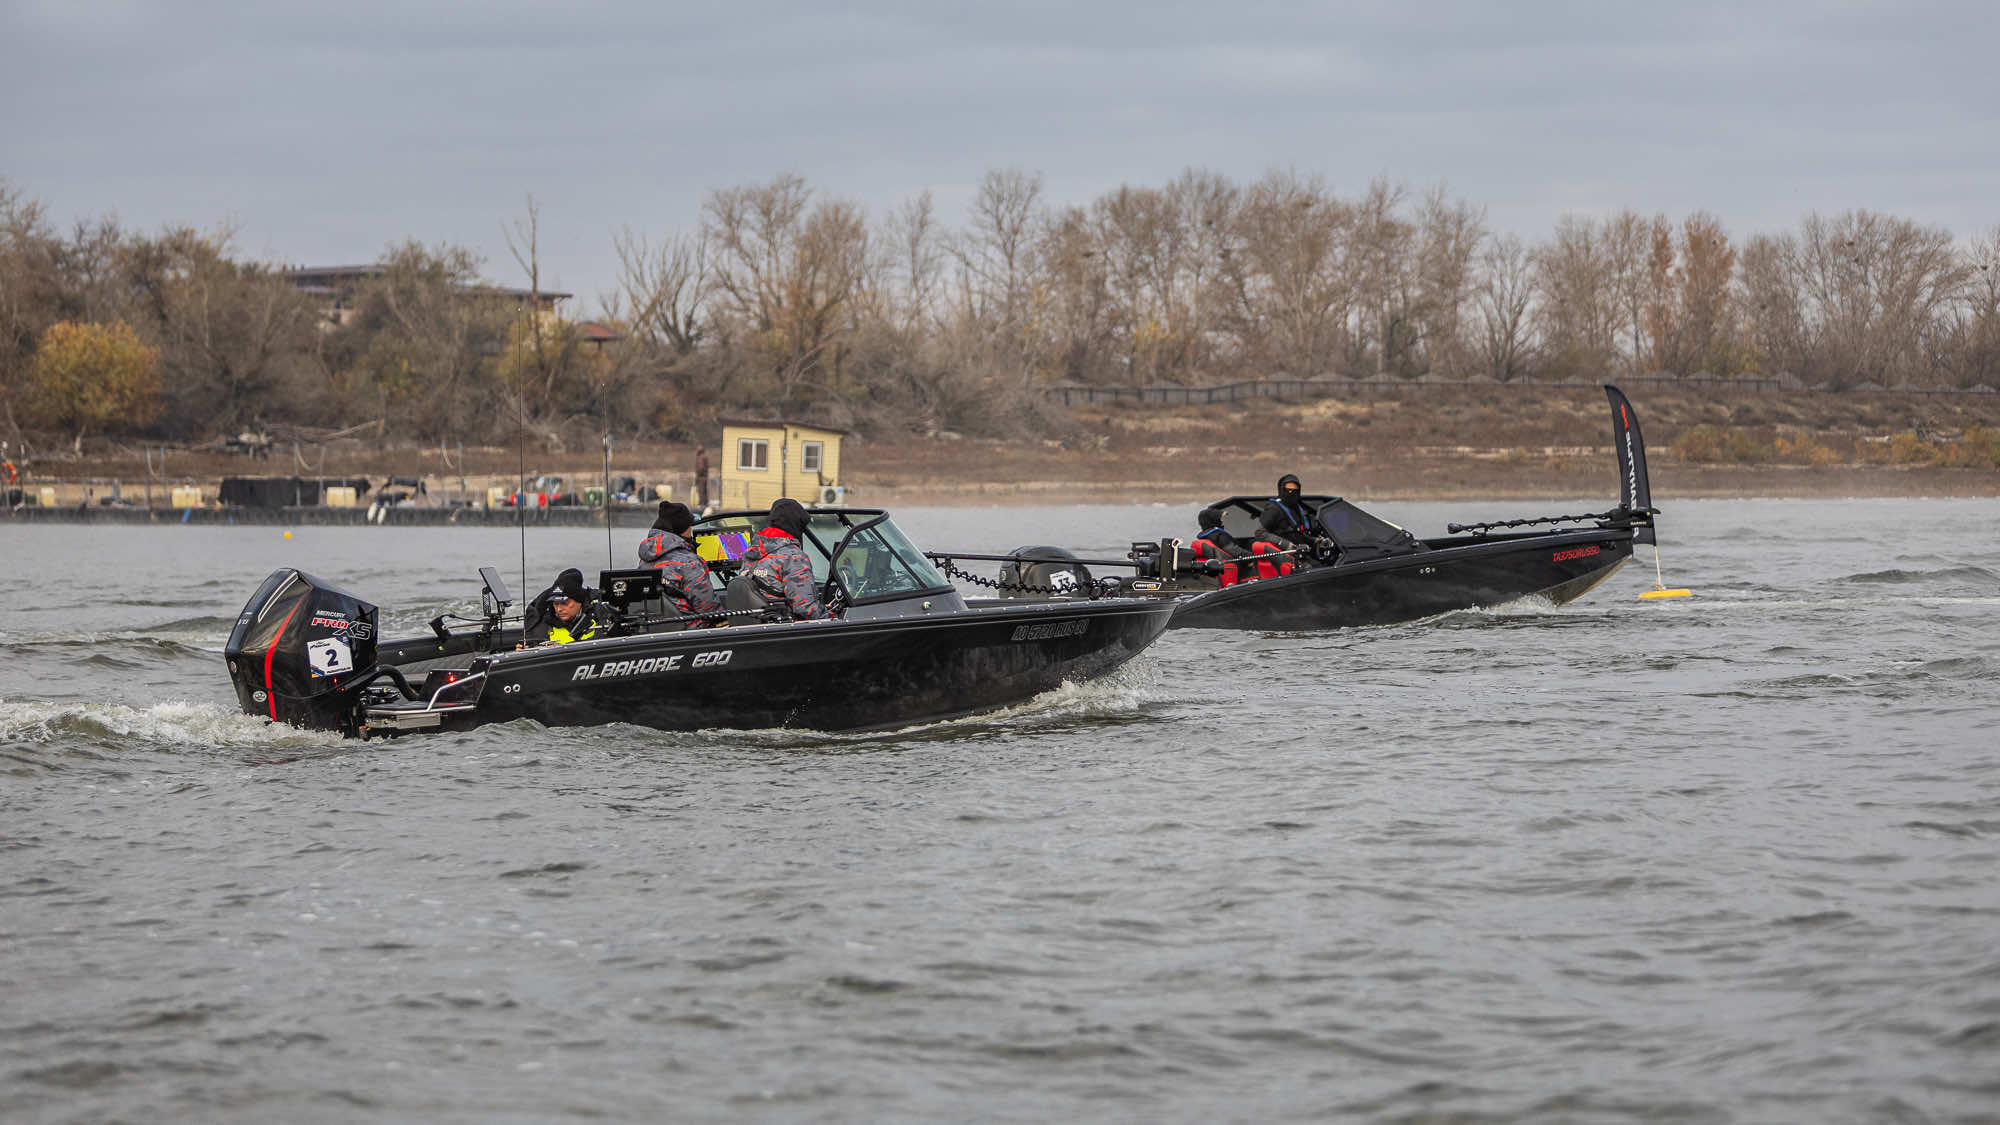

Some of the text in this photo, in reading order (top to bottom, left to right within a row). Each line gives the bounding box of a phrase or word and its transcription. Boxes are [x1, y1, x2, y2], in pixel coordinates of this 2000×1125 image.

[315, 610, 345, 618] MERCURY
[325, 649, 339, 667] 2
[571, 650, 733, 681] ALBAKORE 600
